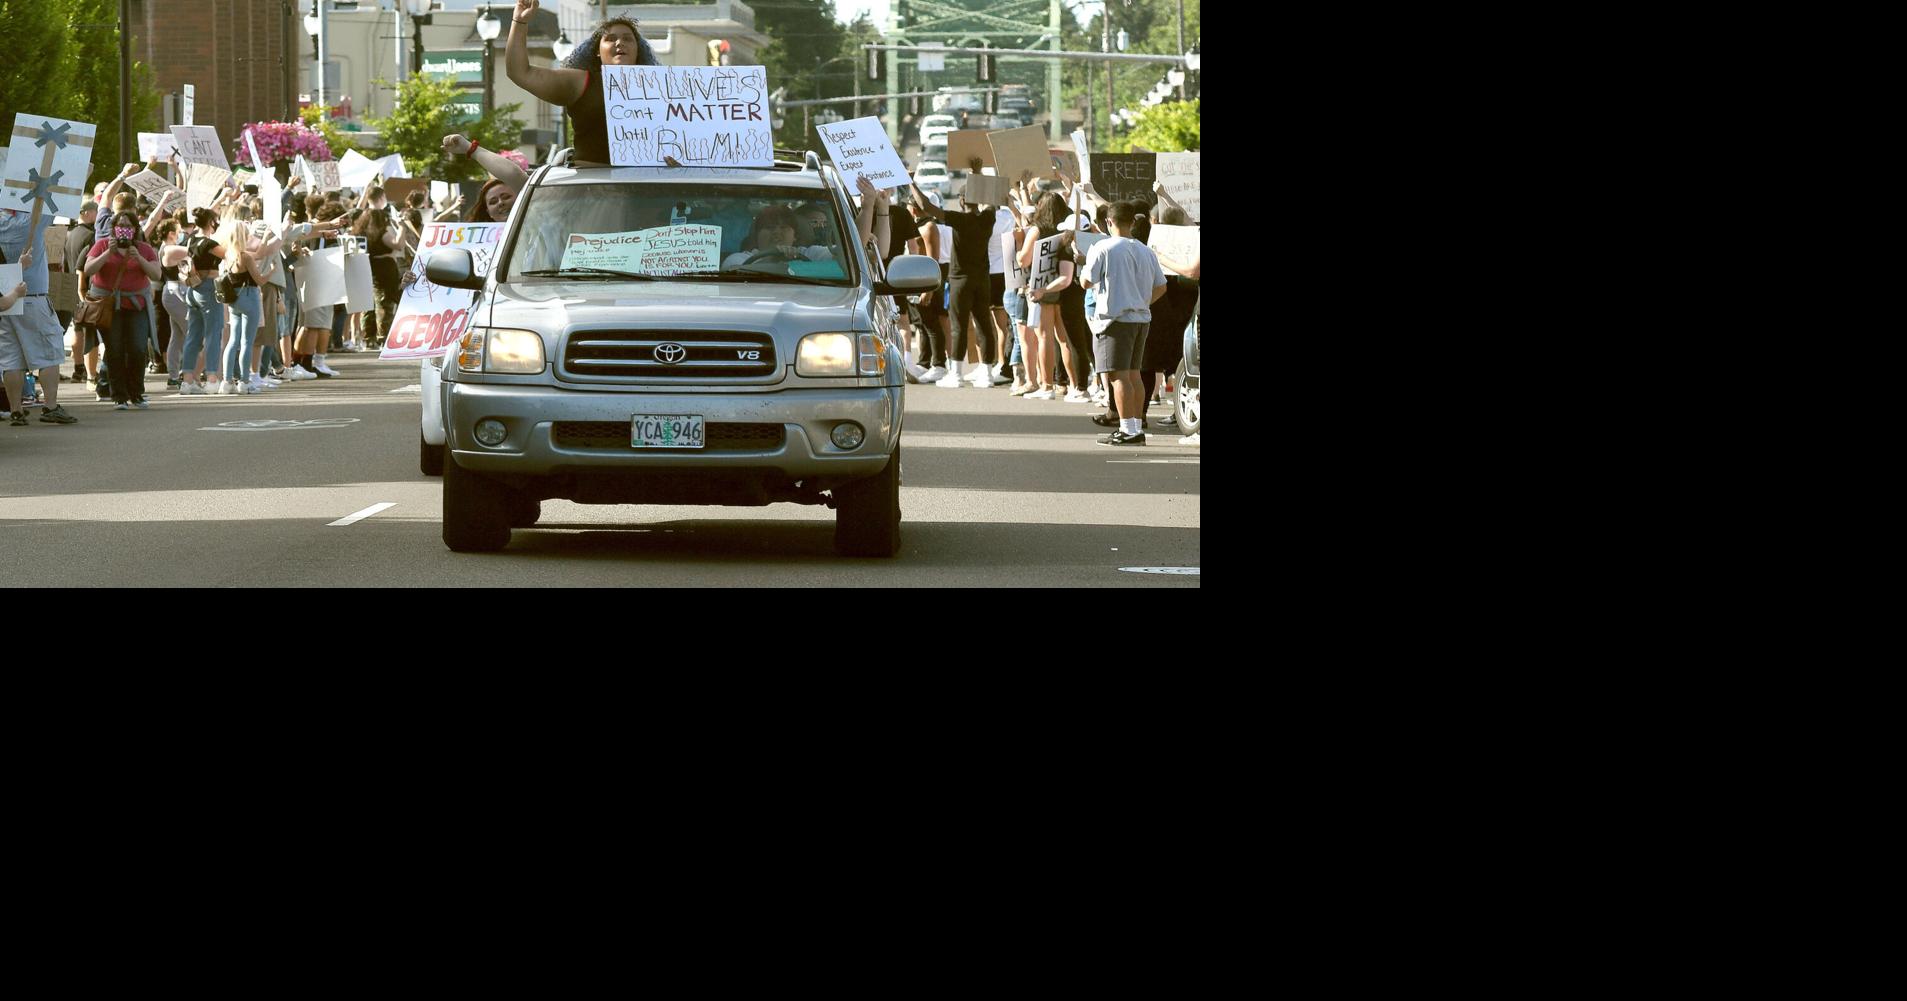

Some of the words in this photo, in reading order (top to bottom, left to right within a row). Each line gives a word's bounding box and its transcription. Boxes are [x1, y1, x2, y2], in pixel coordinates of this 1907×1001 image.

[609, 73, 660, 101] ALL
[665, 102, 762, 122] MATTER
[819, 125, 856, 146] Respect
[613, 125, 649, 142] Until
[656, 128, 743, 163] BLM!
[839, 160, 864, 172] Expect
[1101, 160, 1150, 180] FREE
[568, 235, 642, 249] Prejudice
[643, 238, 687, 251] JESUS
[675, 261, 694, 269] YOU
[692, 255, 708, 263] YOU
[736, 350, 761, 360] V8
[635, 421, 663, 440] YCA
[672, 421, 701, 440] 946
